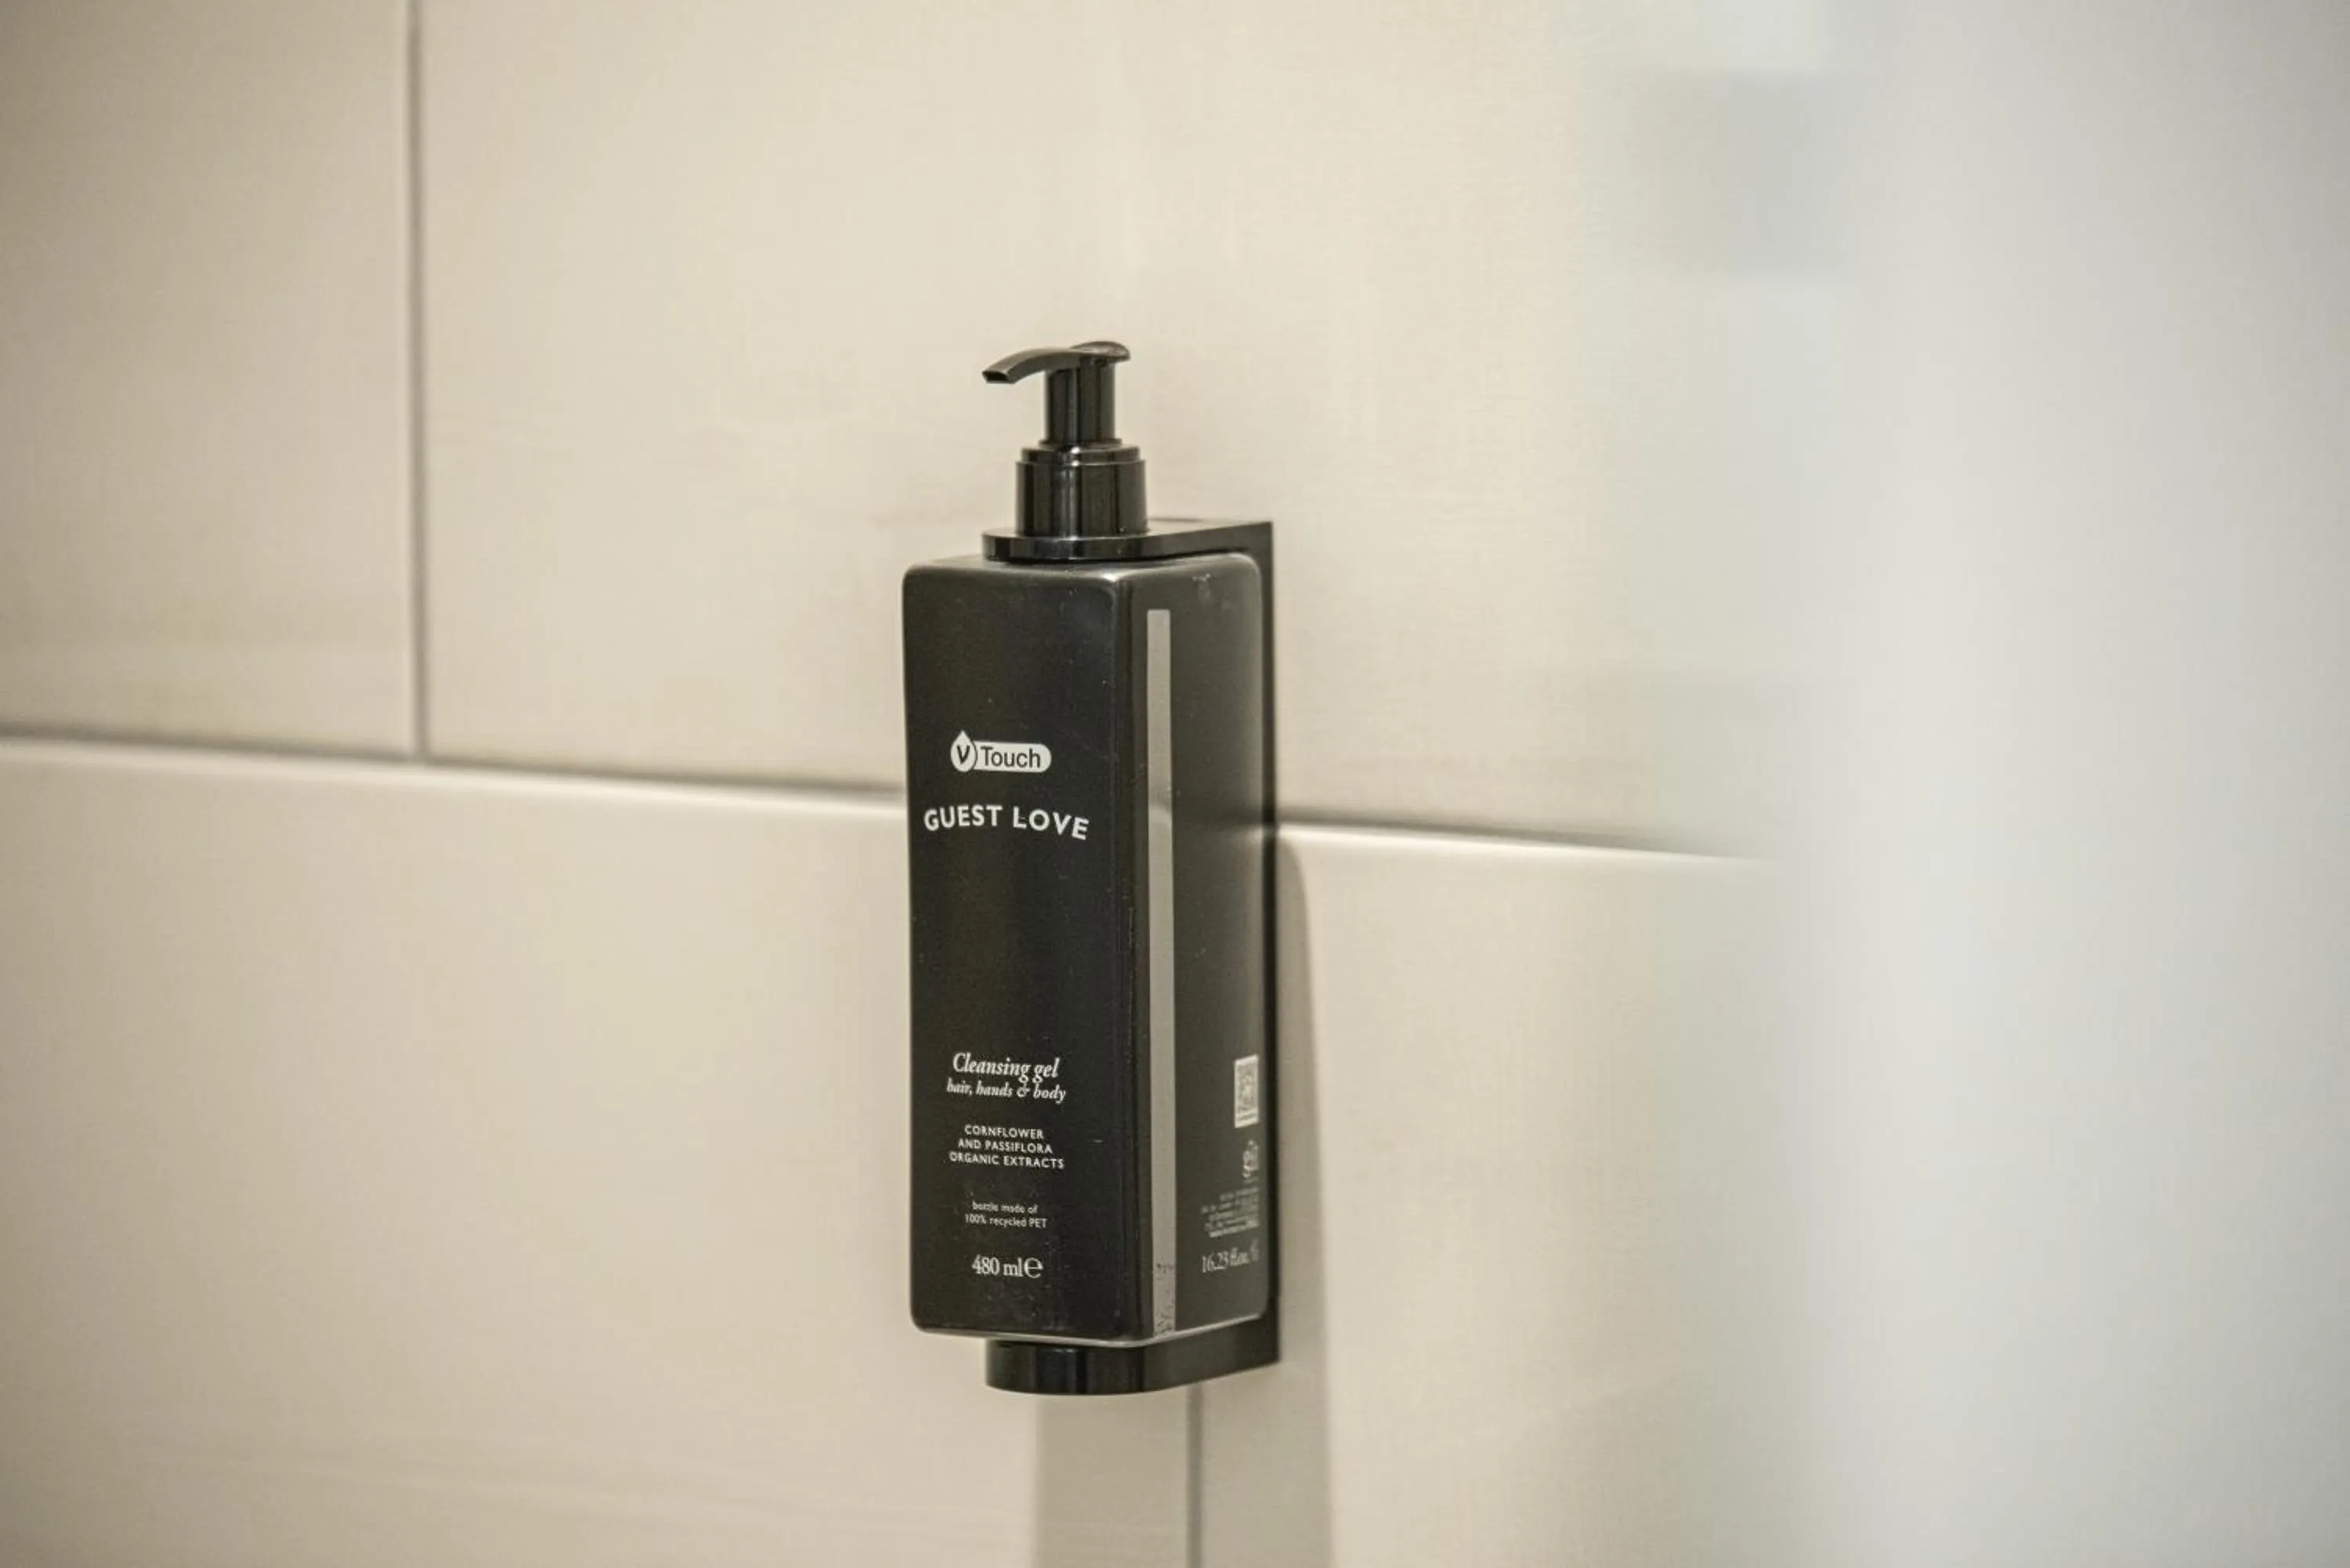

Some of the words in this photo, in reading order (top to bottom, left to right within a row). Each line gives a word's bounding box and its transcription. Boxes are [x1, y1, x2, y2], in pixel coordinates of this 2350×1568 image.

[981, 746, 1041, 768] Touch
[924, 804, 1003, 832] GUEST
[1013, 806, 1090, 840] LOVE
[953, 1052, 1031, 1084] Cleansing
[1032, 1057, 1061, 1084] gel
[946, 1077, 973, 1096] hair,
[975, 1080, 1013, 1097] hands
[1016, 1082, 1031, 1097] &
[1033, 1082, 1066, 1104] body
[964, 1124, 1044, 1140] CORNFLOWER
[958, 1137, 982, 1149] AND
[985, 1140, 1054, 1154] PASSIFLORA
[949, 1151, 1000, 1165] ORGANIC
[1003, 1155, 1065, 1169] EXTRACTS
[972, 1200, 999, 1212] bottle
[1000, 1202, 1025, 1213] made
[1027, 1204, 1039, 1214] of
[965, 1213, 987, 1224] 100%
[989, 1217, 1027, 1228] recycled
[1029, 1218, 1047, 1229] PET
[971, 1255, 1000, 1275] 480
